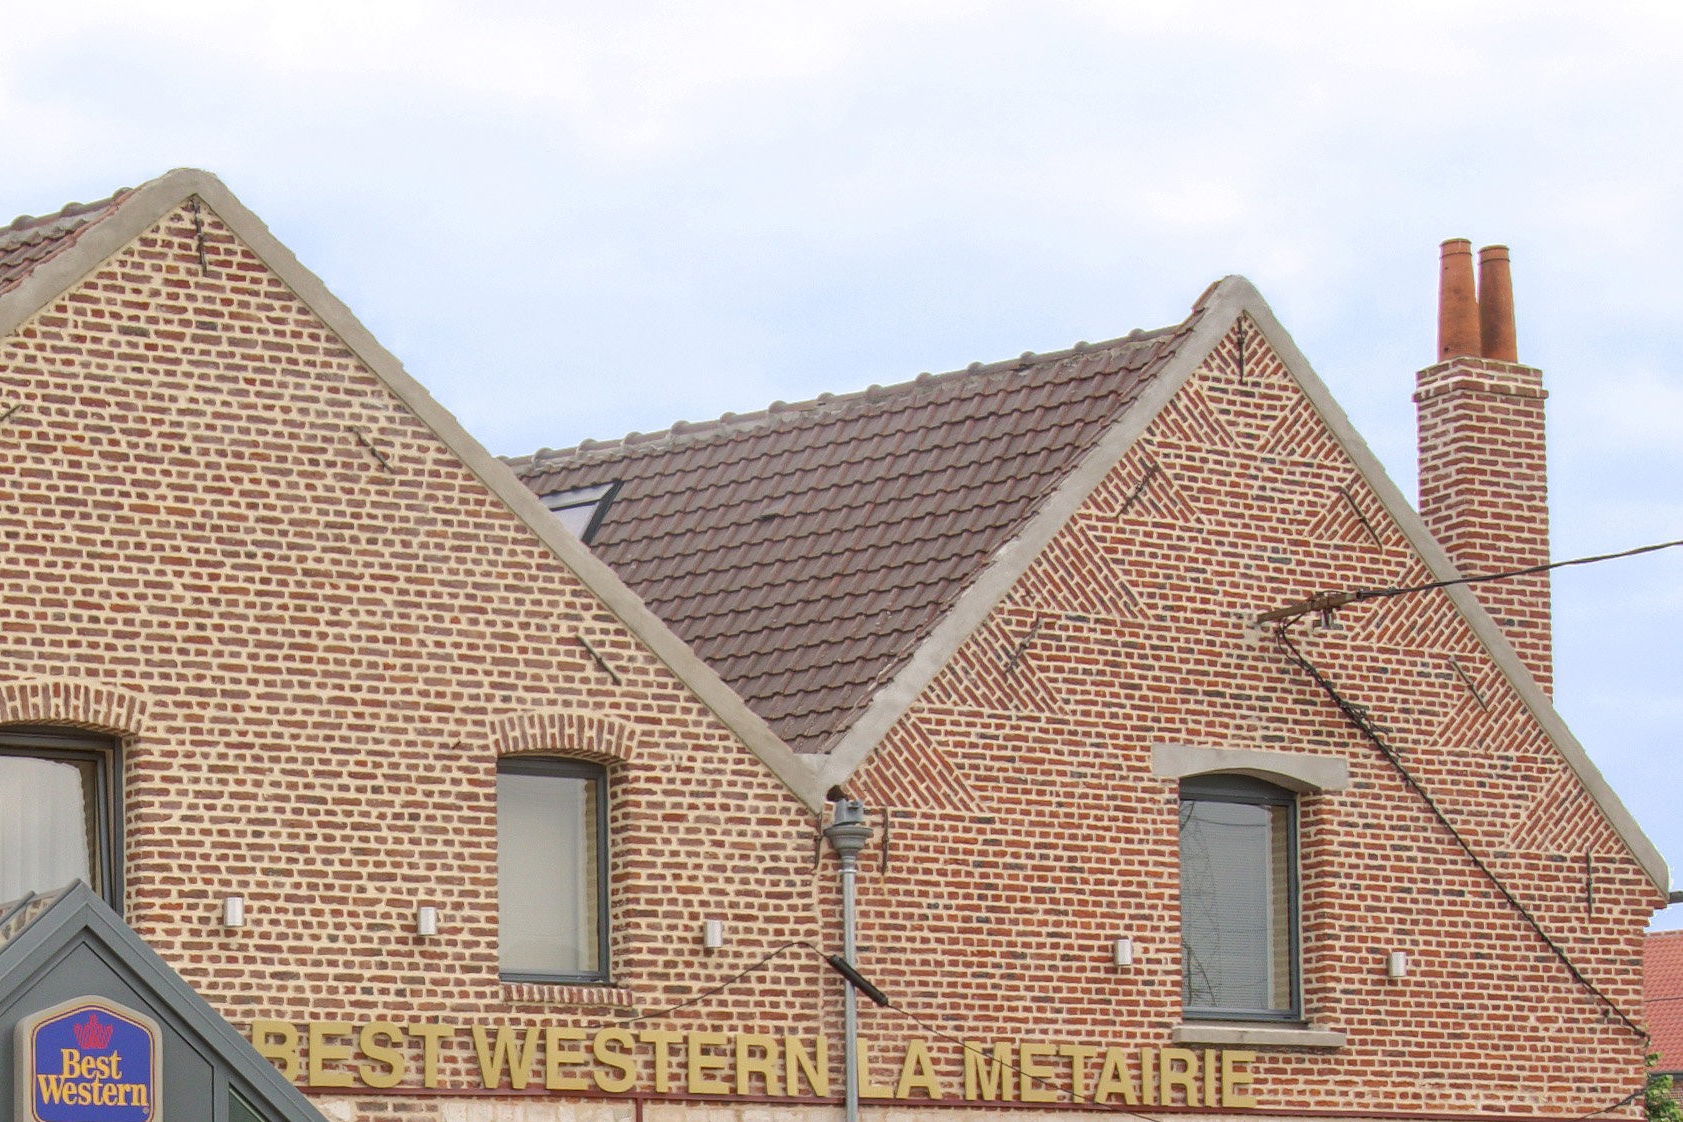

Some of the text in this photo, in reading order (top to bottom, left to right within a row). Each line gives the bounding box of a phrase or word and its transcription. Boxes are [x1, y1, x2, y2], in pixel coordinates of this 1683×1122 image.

[60, 1048, 122, 1080] Best
[252, 1020, 1258, 1108] BEST WESTERN LA METAIRIE
[37, 1070, 150, 1106] Western
